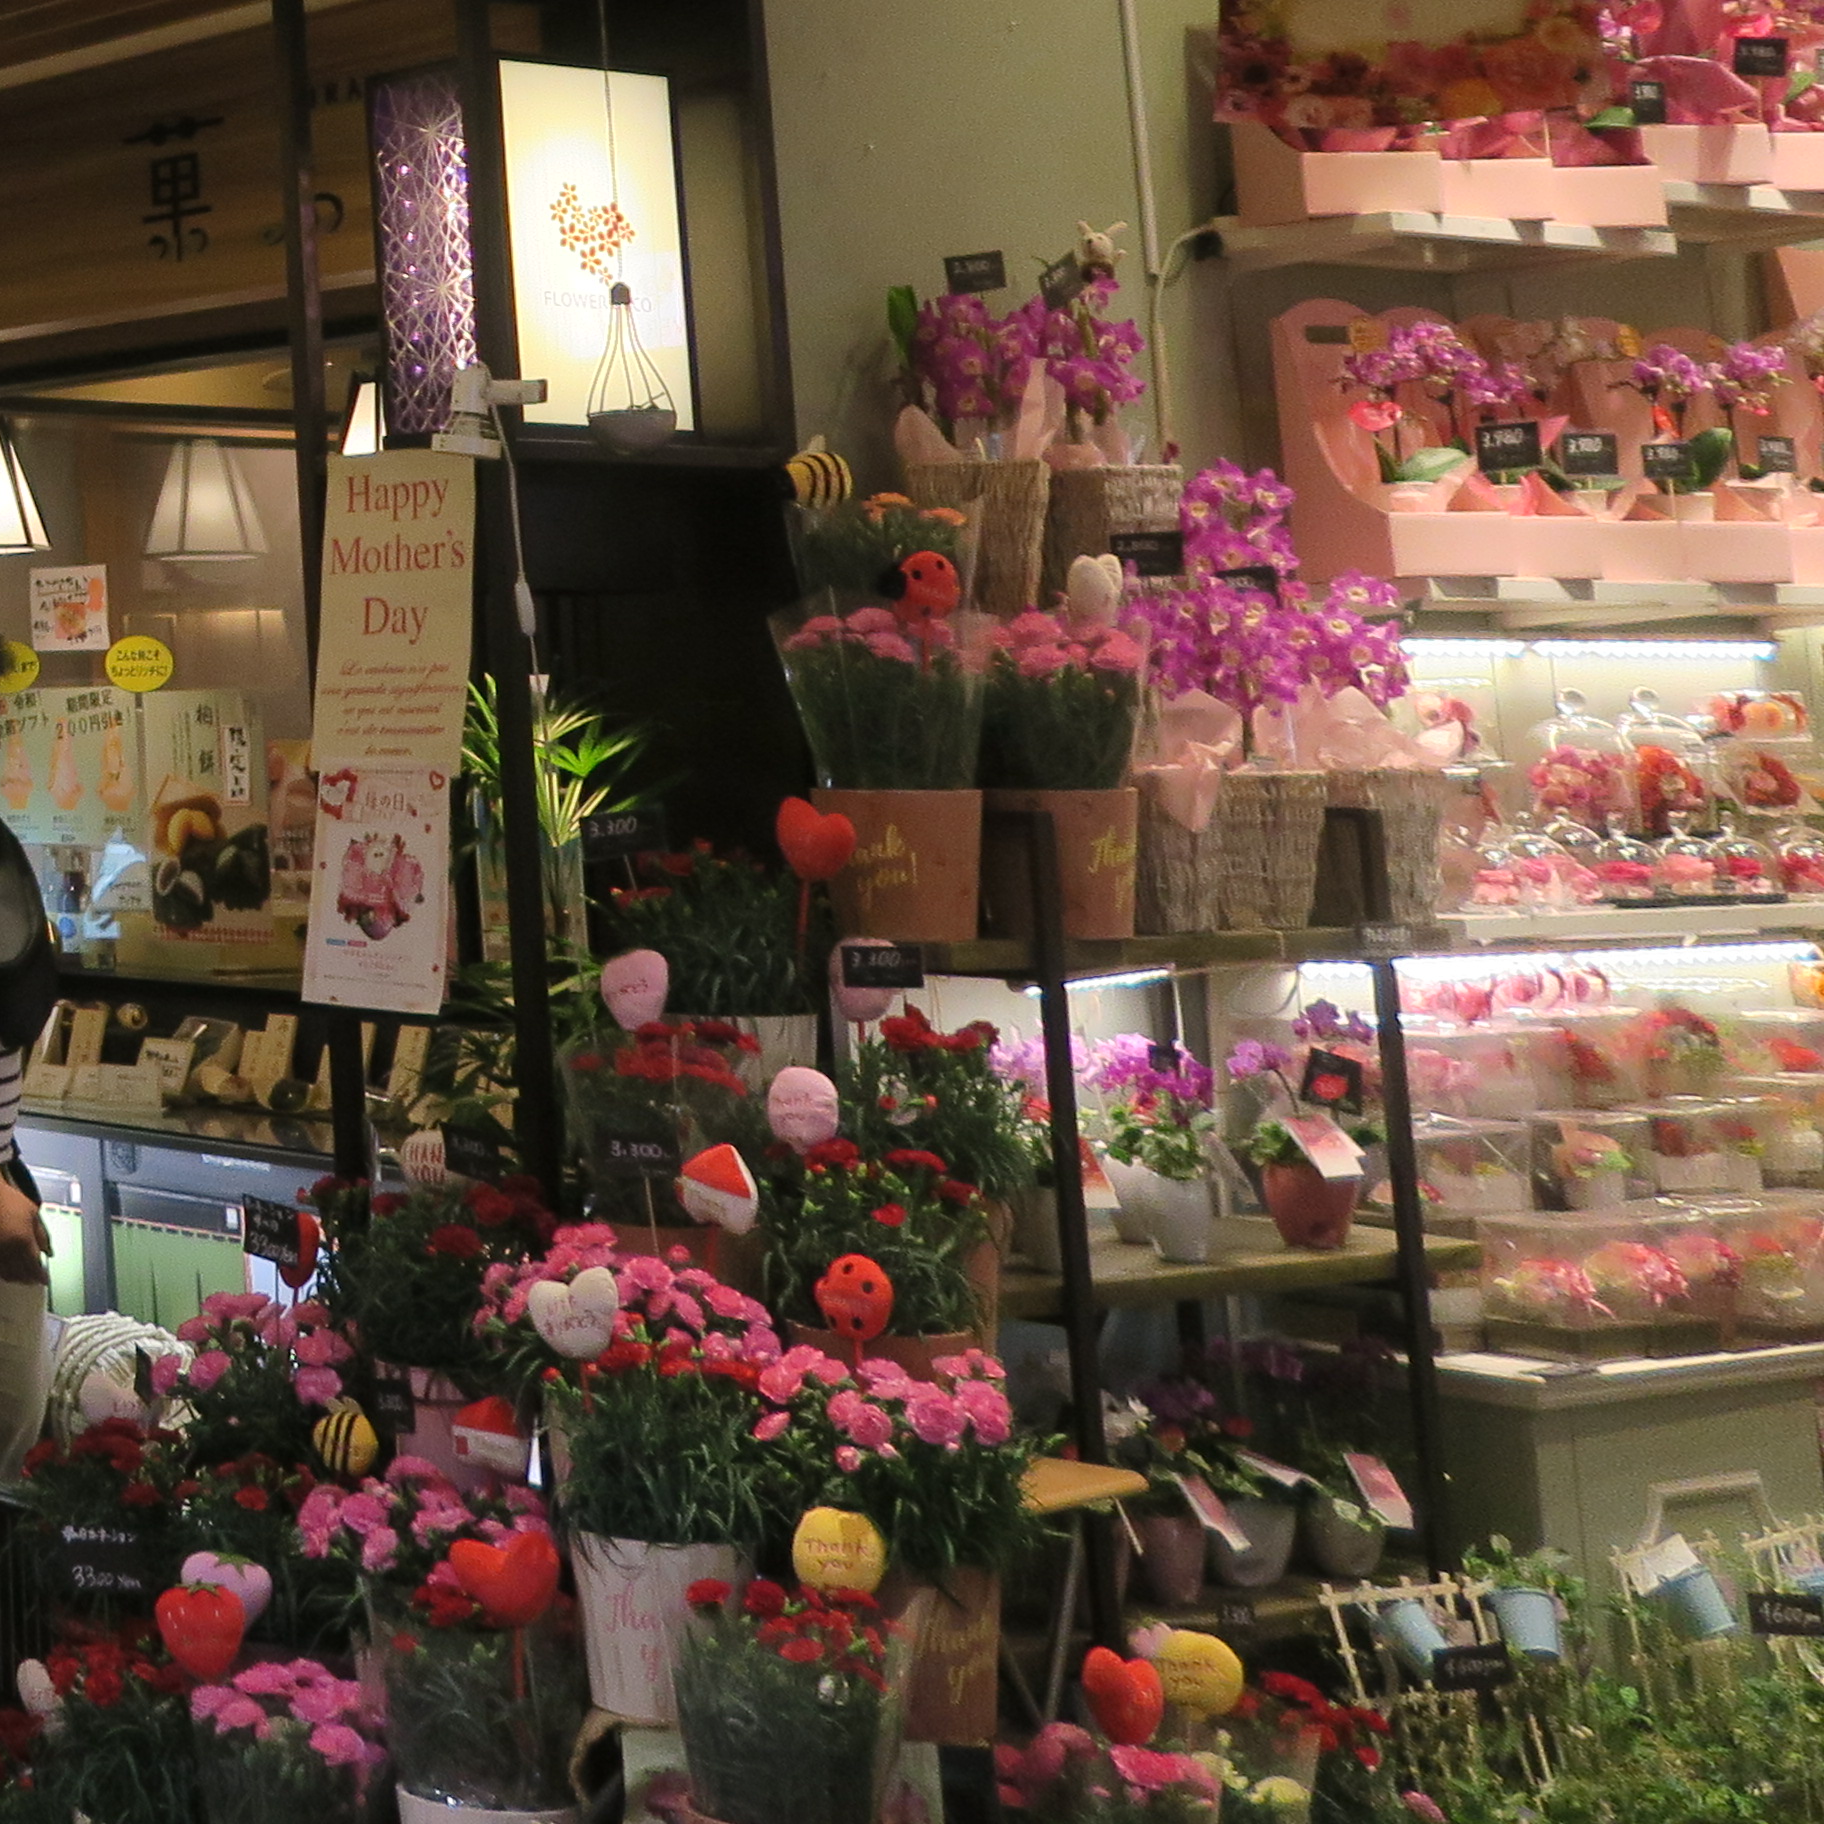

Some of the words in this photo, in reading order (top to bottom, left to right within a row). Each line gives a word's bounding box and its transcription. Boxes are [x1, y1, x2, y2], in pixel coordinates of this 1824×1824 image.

[543, 290, 609, 309] FLOWER
[345, 474, 450, 522] Happy
[329, 529, 466, 576] Mother's
[362, 597, 429, 645] Day
[804, 1537, 871, 1556] Thank
[72, 1564, 114, 1588] 3300
[816, 1558, 853, 1576] you
